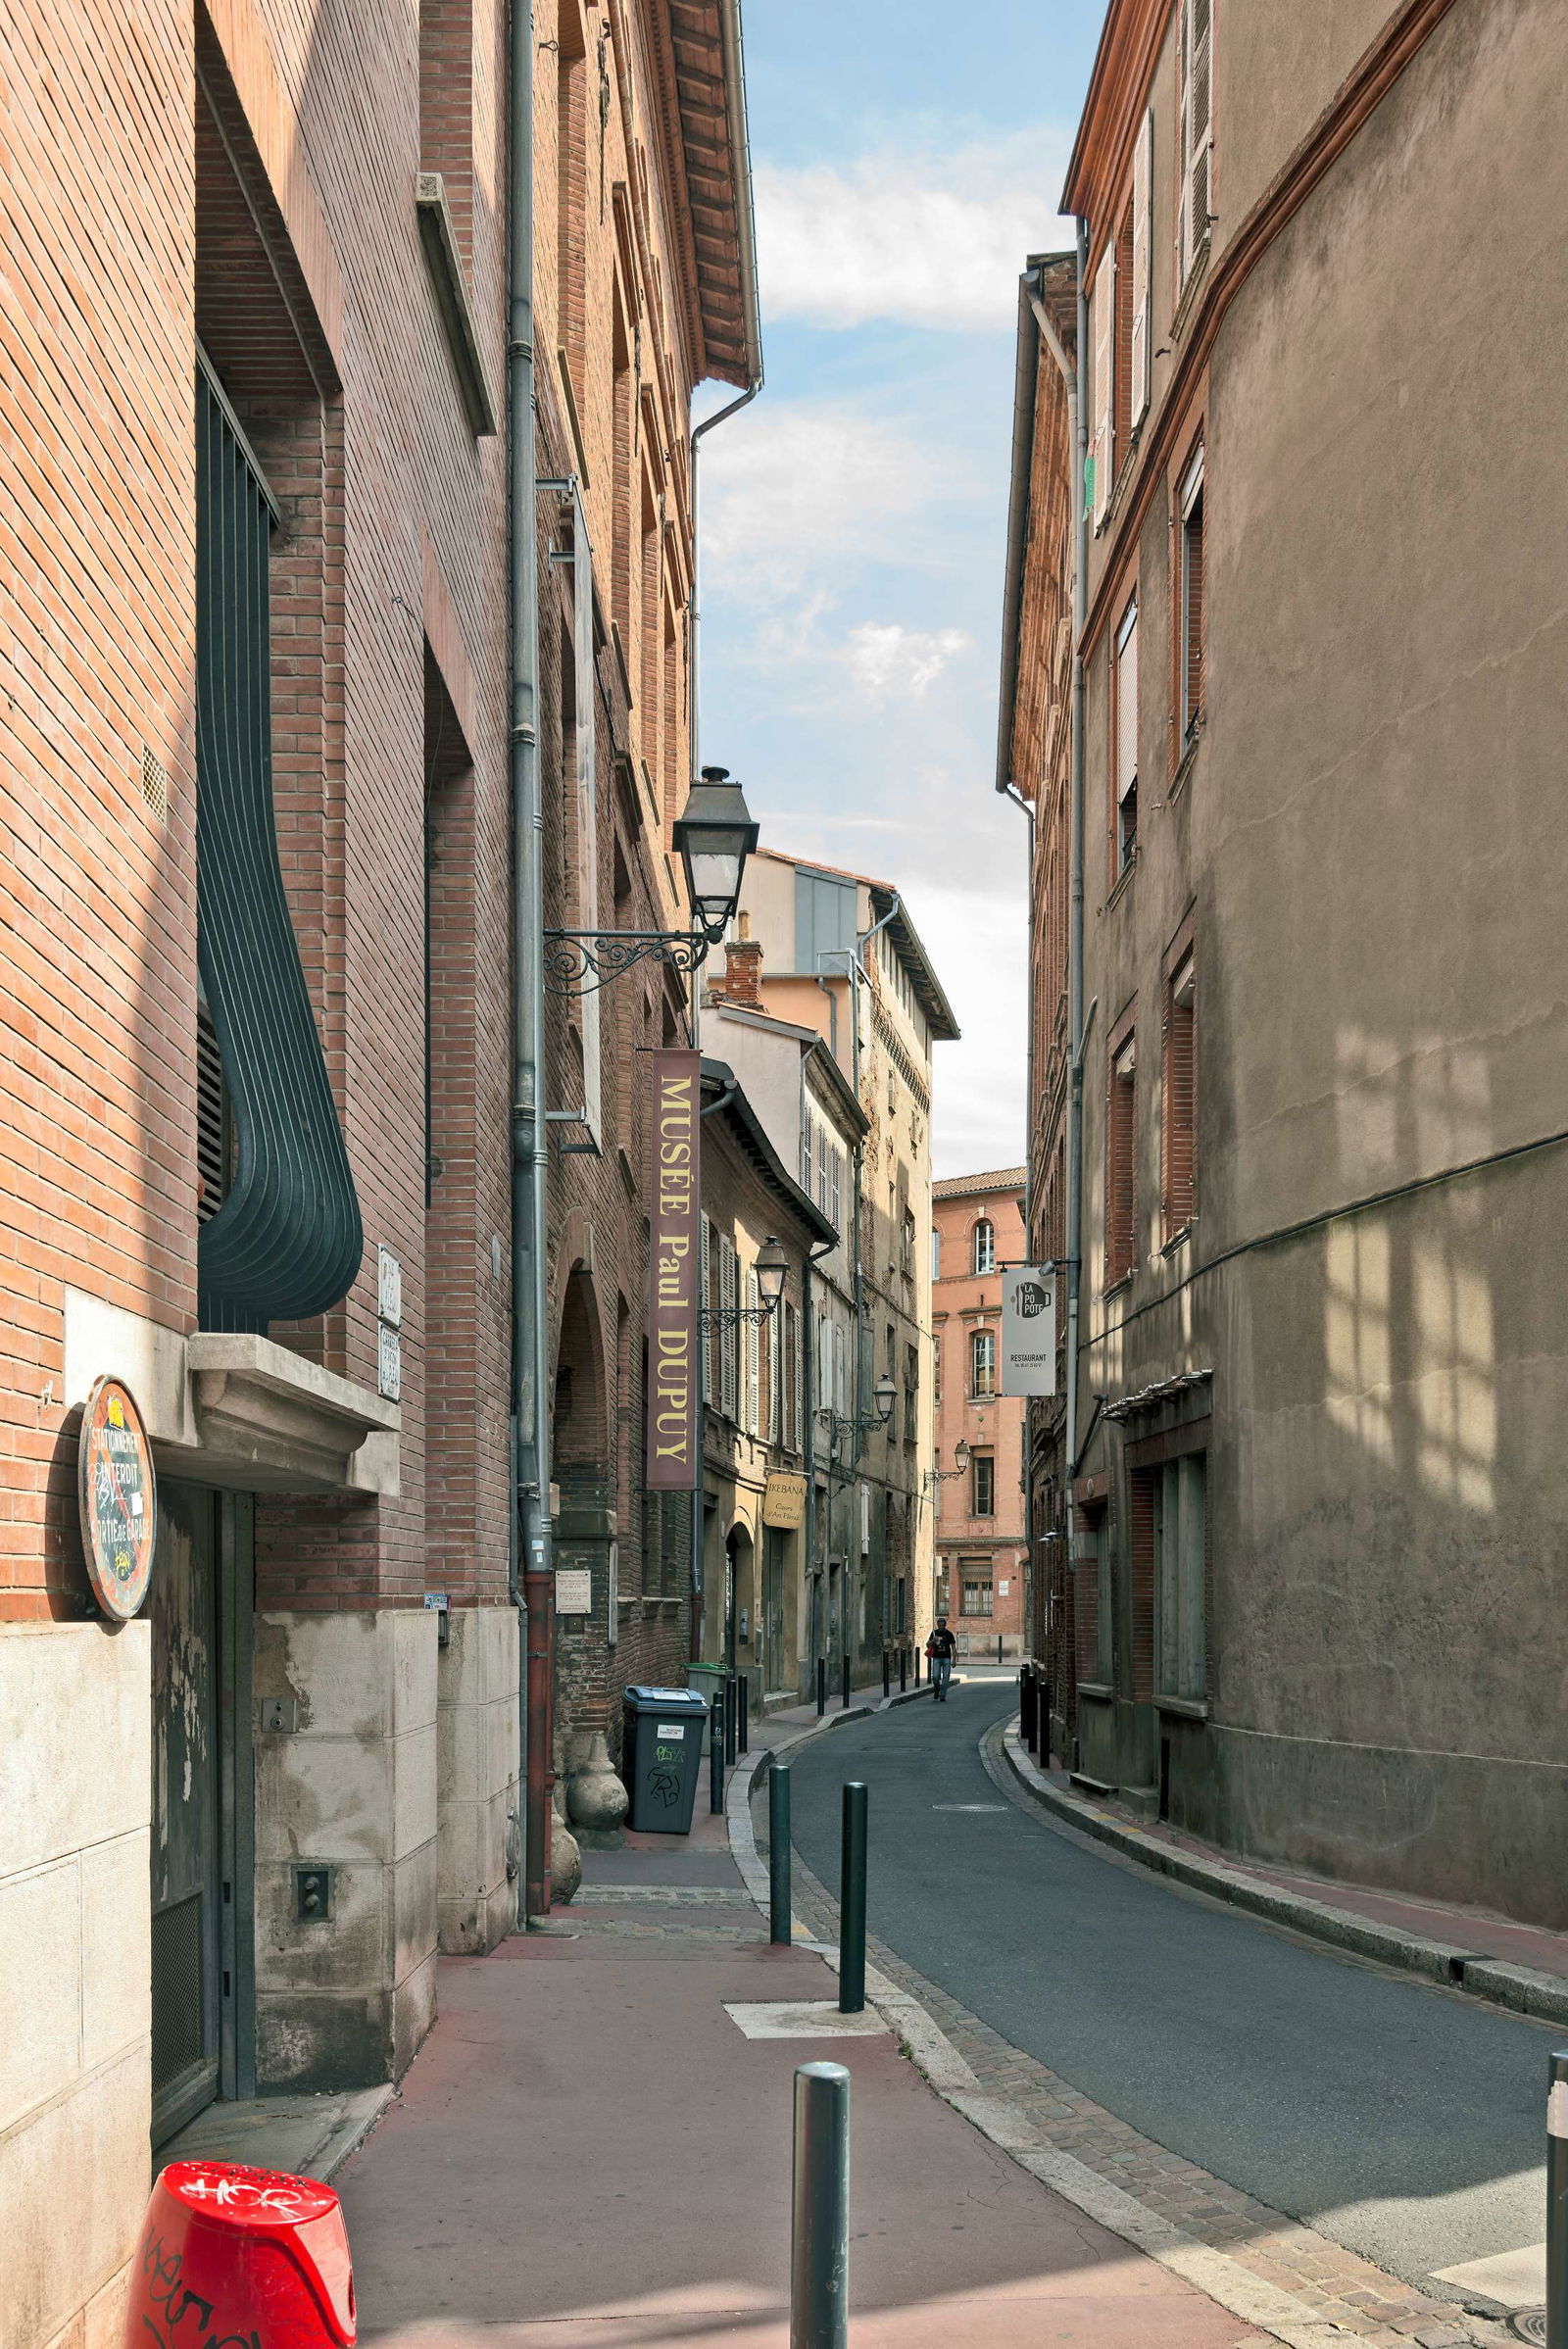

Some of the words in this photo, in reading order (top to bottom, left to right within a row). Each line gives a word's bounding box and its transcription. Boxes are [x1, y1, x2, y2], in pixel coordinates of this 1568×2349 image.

[660, 1075, 694, 1216] MUSÉE
[658, 1233, 689, 1309] Paul
[1024, 1284, 1034, 1294] LA
[1024, 1294, 1035, 1304] PO
[1024, 1303, 1044, 1314] POTE
[1010, 1353, 1047, 1362] RESTAURANT
[656, 1327, 688, 1464] DUPUY
[91, 1428, 141, 1454] STATIONNEMENT
[101, 1462, 138, 1486] INTERDIT
[768, 1483, 805, 1496] IKEBANA
[775, 1502, 793, 1511] Cours
[91, 1517, 118, 1544] SORTIE
[126, 1518, 150, 1542] GARAGE
